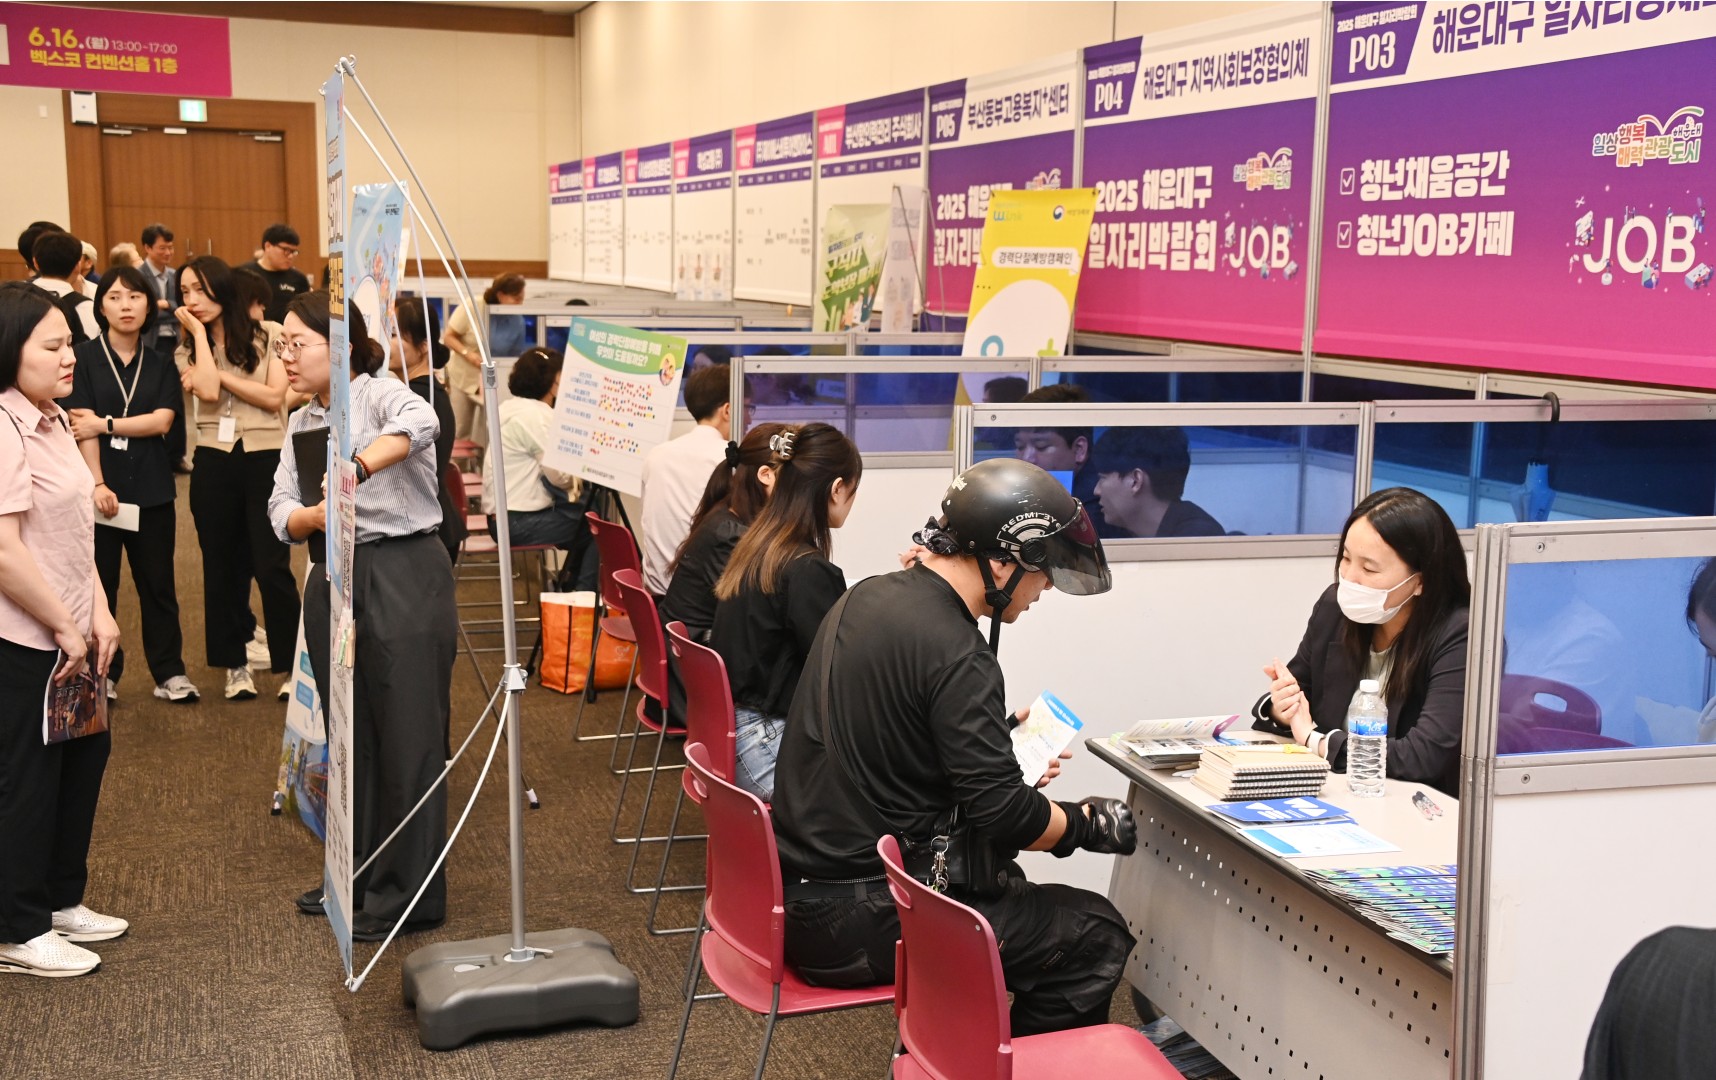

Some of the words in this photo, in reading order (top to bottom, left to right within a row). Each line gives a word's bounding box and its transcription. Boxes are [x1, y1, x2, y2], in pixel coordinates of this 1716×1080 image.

[1433, 1, 1535, 54] 해운대구
[30, 49, 82, 68] 벡스코
[85, 53, 151, 73] 컨벤션홀
[153, 57, 178, 74] 1층
[1143, 61, 1188, 100] 해운대구
[1190, 37, 1310, 93] 지역사회보장협의체
[1349, 31, 1396, 73] P03
[1094, 80, 1124, 112] P04
[1618, 123, 1646, 144] 행복
[1095, 179, 1138, 212] 2025
[1142, 166, 1213, 210] 해운대구
[1360, 150, 1510, 201] 청년채움공간
[937, 194, 966, 220] 2025
[1088, 219, 1217, 271] 일자리박람회
[1229, 226, 1291, 269] JOB
[1357, 211, 1515, 257] 청년JOB카페
[1583, 215, 1696, 273] JOB
[998, 251, 1073, 265] 경력단절예방캠페인
